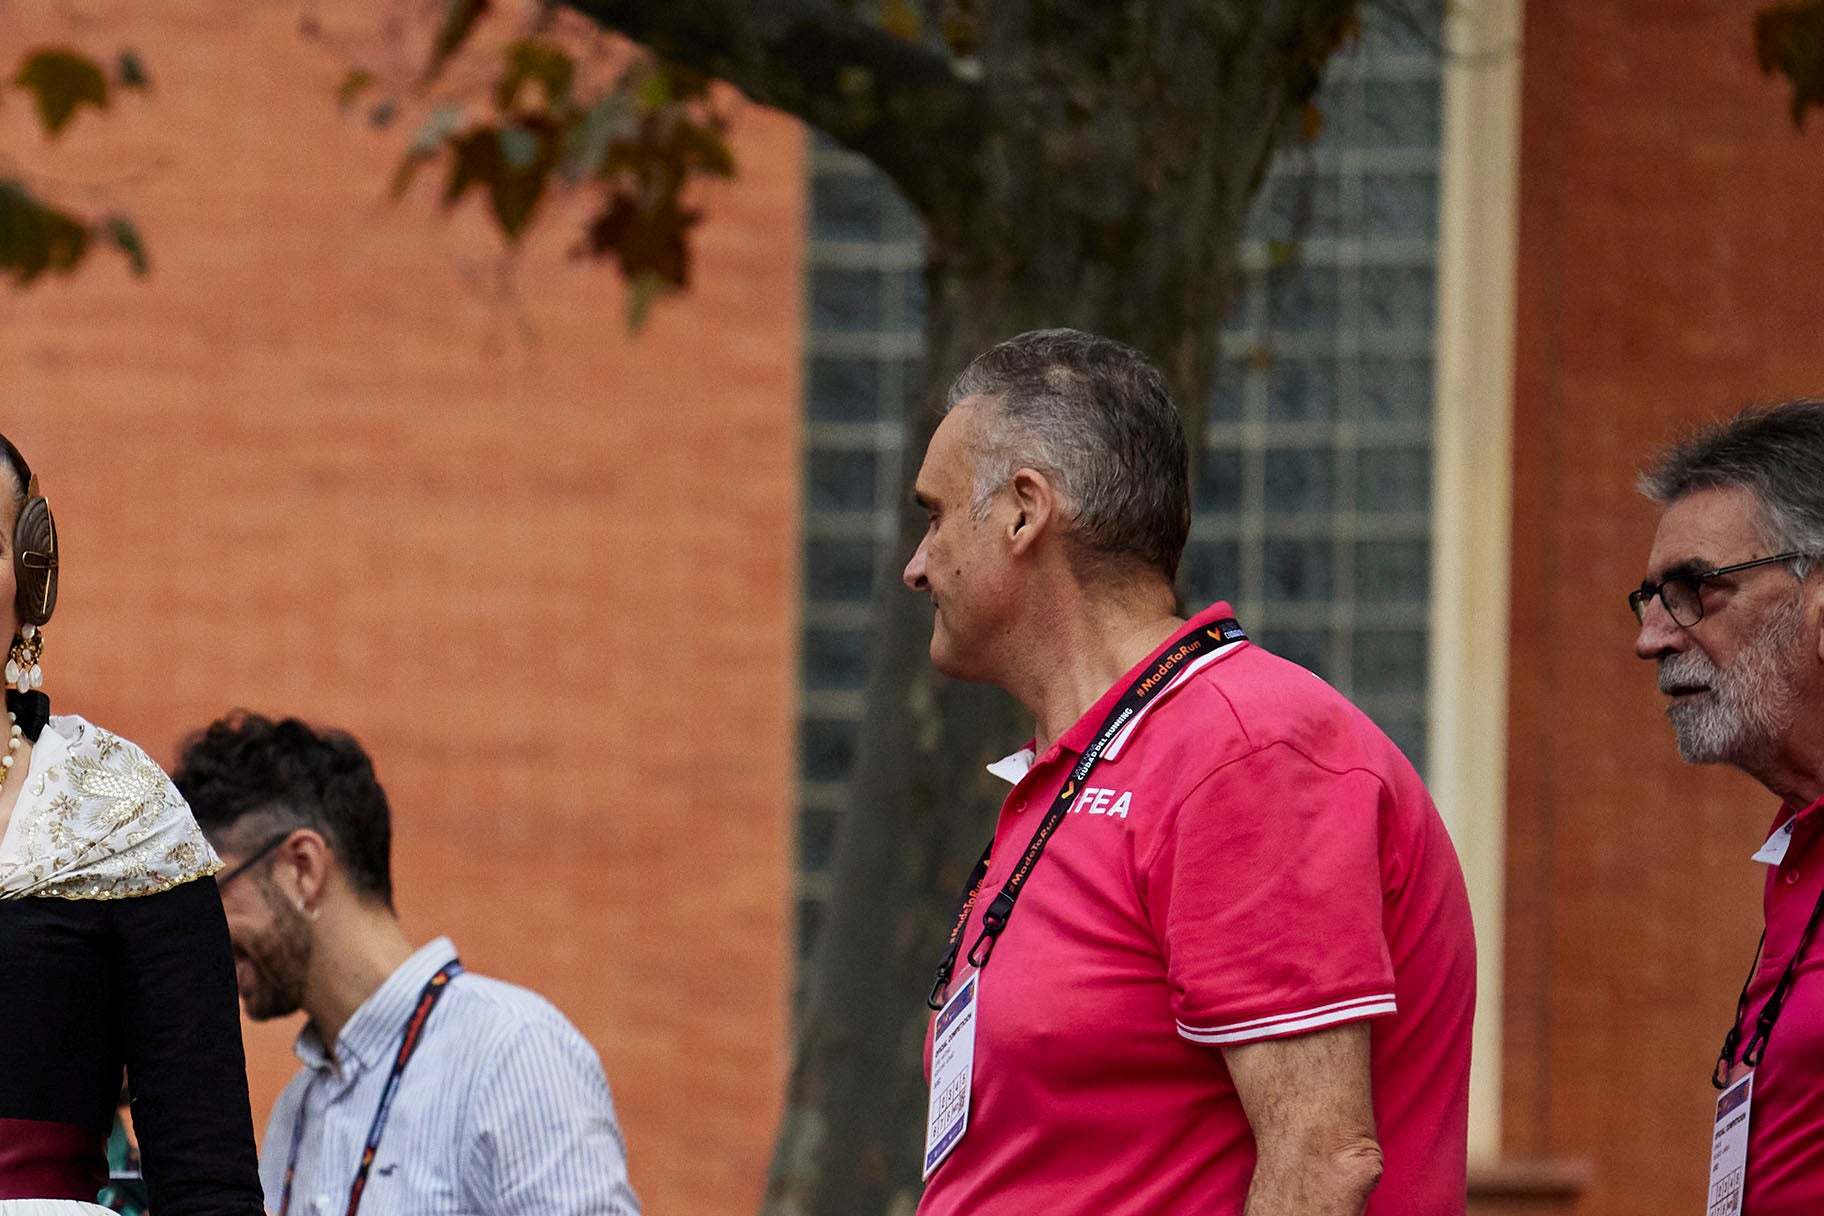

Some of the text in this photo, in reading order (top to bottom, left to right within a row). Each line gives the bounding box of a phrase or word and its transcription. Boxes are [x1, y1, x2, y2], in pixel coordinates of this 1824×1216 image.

[1136, 640, 1202, 698] #MadeToRun
[1077, 707, 1134, 781] CIUDAD DEL RUNNING
[1008, 814, 1057, 893] #MadeToRun
